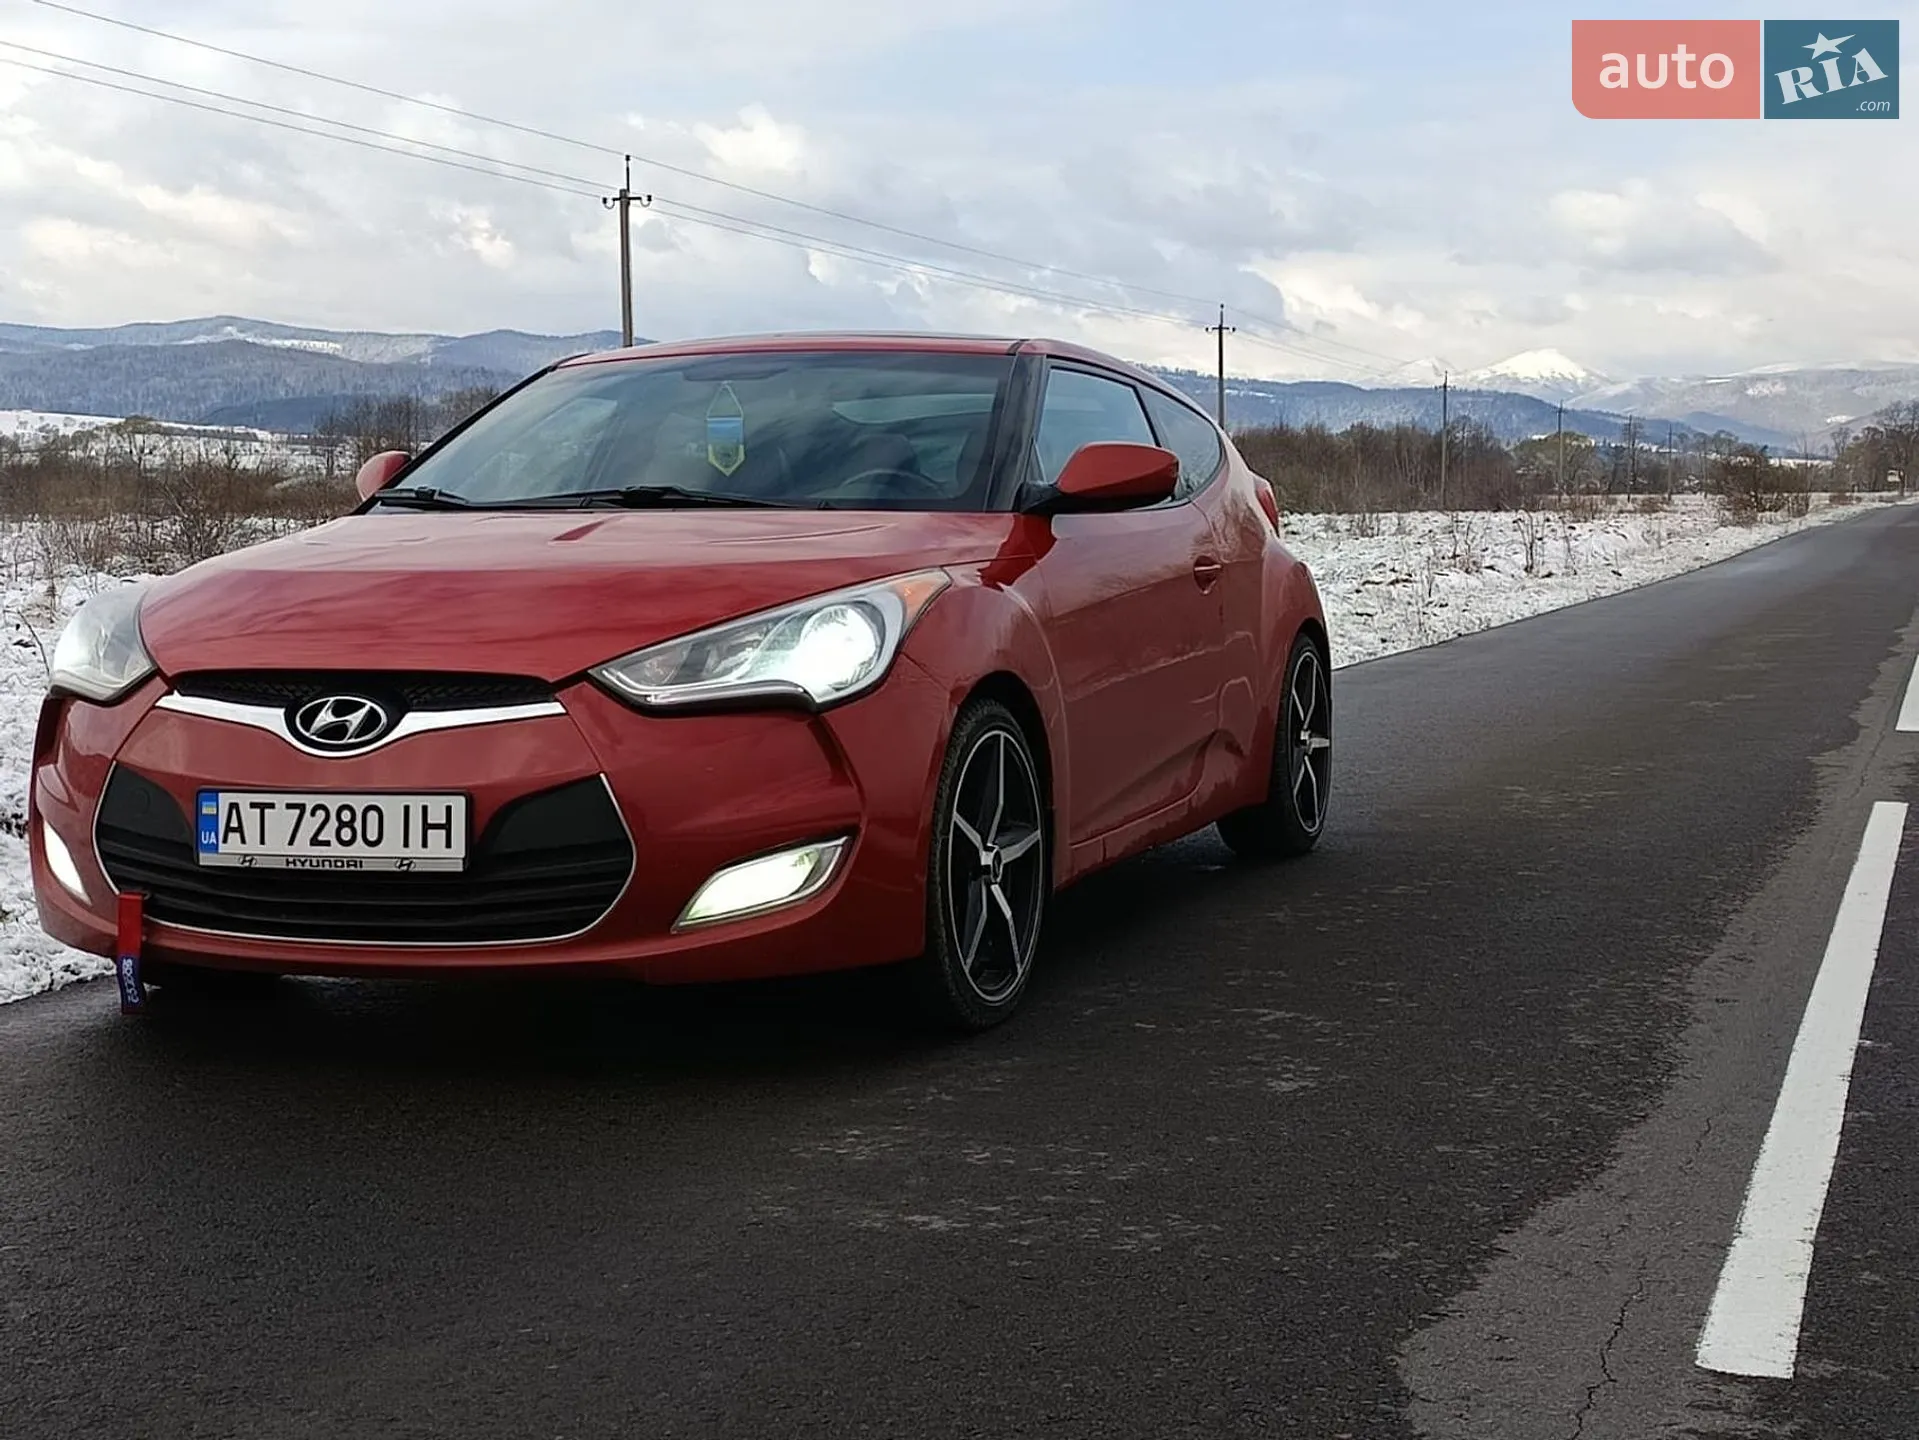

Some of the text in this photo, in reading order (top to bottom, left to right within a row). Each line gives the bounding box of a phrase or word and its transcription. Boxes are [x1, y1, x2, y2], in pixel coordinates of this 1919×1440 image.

[221, 801, 453, 849] AT 7280 IH
[201, 831, 217, 845] UA
[285, 857, 364, 869] HYUNDAI
